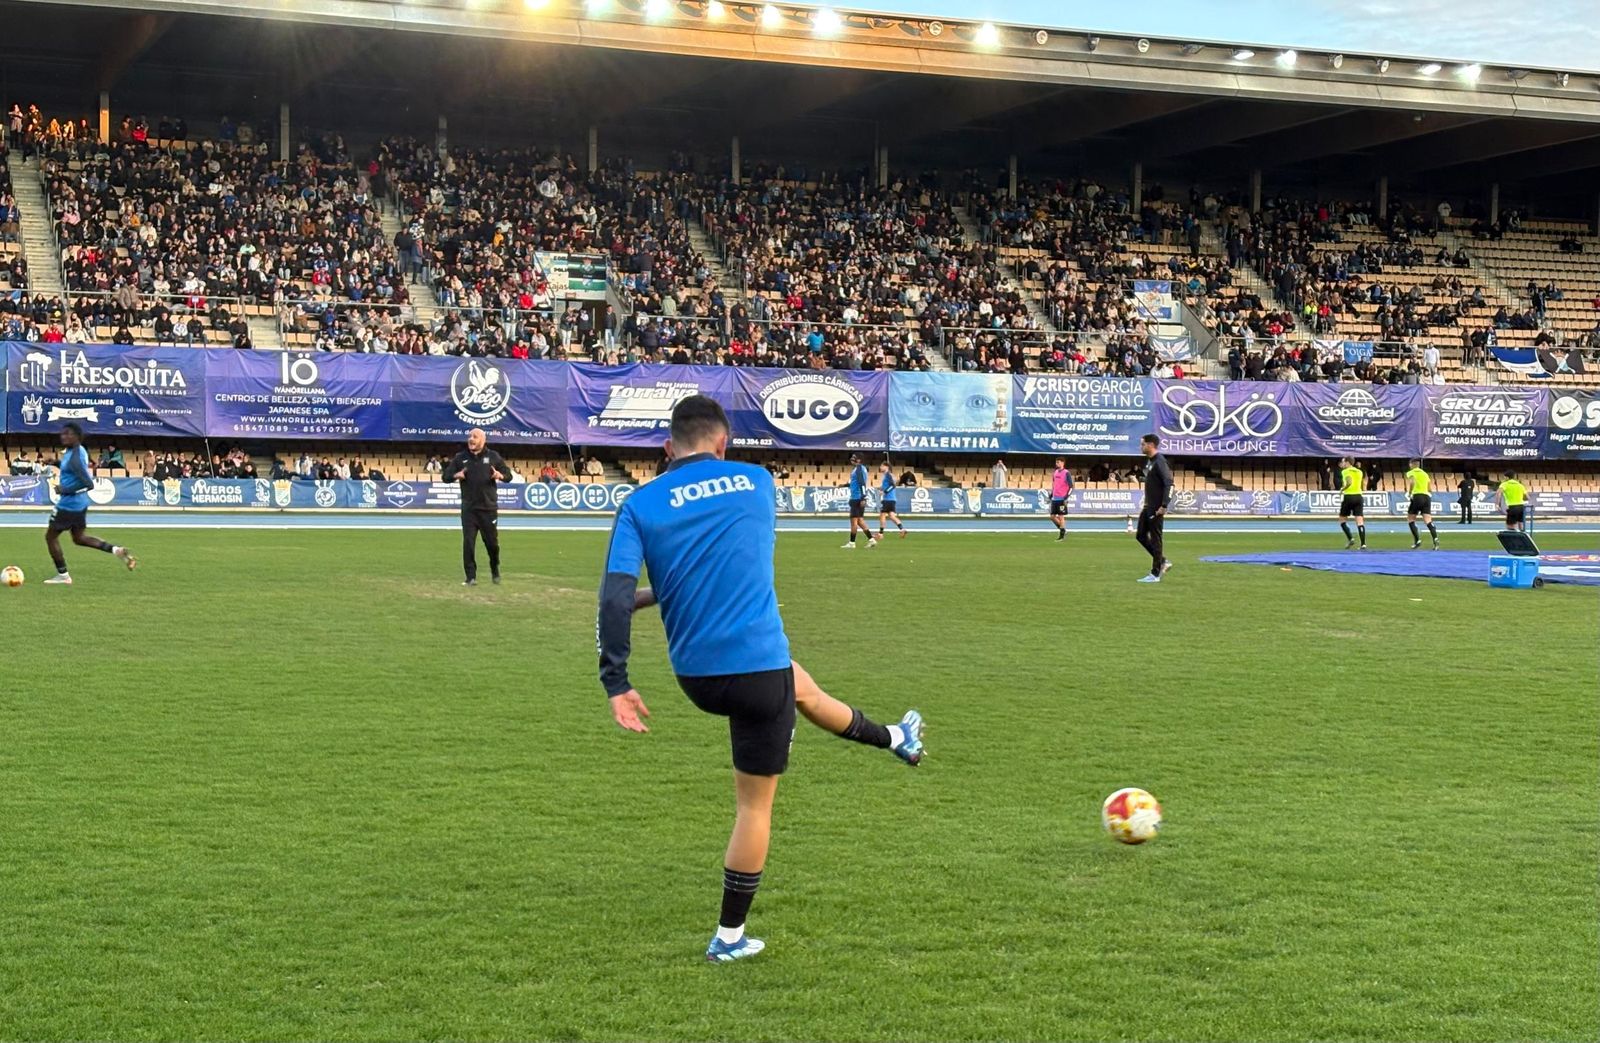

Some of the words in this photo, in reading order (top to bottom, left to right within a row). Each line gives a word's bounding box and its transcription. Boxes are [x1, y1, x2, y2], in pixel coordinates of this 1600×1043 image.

[60, 350, 90, 367] LA
[60, 366, 186, 387] FRESQUITA
[759, 374, 824, 399] DISTRIBUCIONES
[825, 375, 864, 402] CÁRNICAS
[71, 398, 114, 406] BOTELLINES
[215, 394, 256, 403] CENTROS
[257, 395, 270, 403] DE
[271, 396, 310, 405] BELLEZA,
[311, 397, 328, 405] SPA
[329, 397, 336, 405] Y
[336, 397, 382, 406] BIENESTAR
[460, 385, 502, 410] Diego
[1037, 393, 1144, 407] MARKETING
[1440, 396, 1526, 412] GRÚAS
[268, 407, 311, 415] JAPANESE
[770, 398, 854, 420] LUGO
[1319, 405, 1395, 418] GlobalPadel
[1343, 418, 1370, 426] CLUB
[1440, 412, 1474, 426] SAN
[1476, 414, 1526, 427] TELMO
[1061, 423, 1076, 431] 621
[1433, 427, 1486, 436] PLATAFORMAS
[1486, 429, 1510, 437] HASTA
[1520, 429, 1537, 437] MTS.
[908, 436, 1000, 449] VALENTINA
[1160, 439, 1215, 451] SHISHA
[1218, 441, 1278, 452] LOUNGE
[1444, 437, 1470, 445] GRUAS
